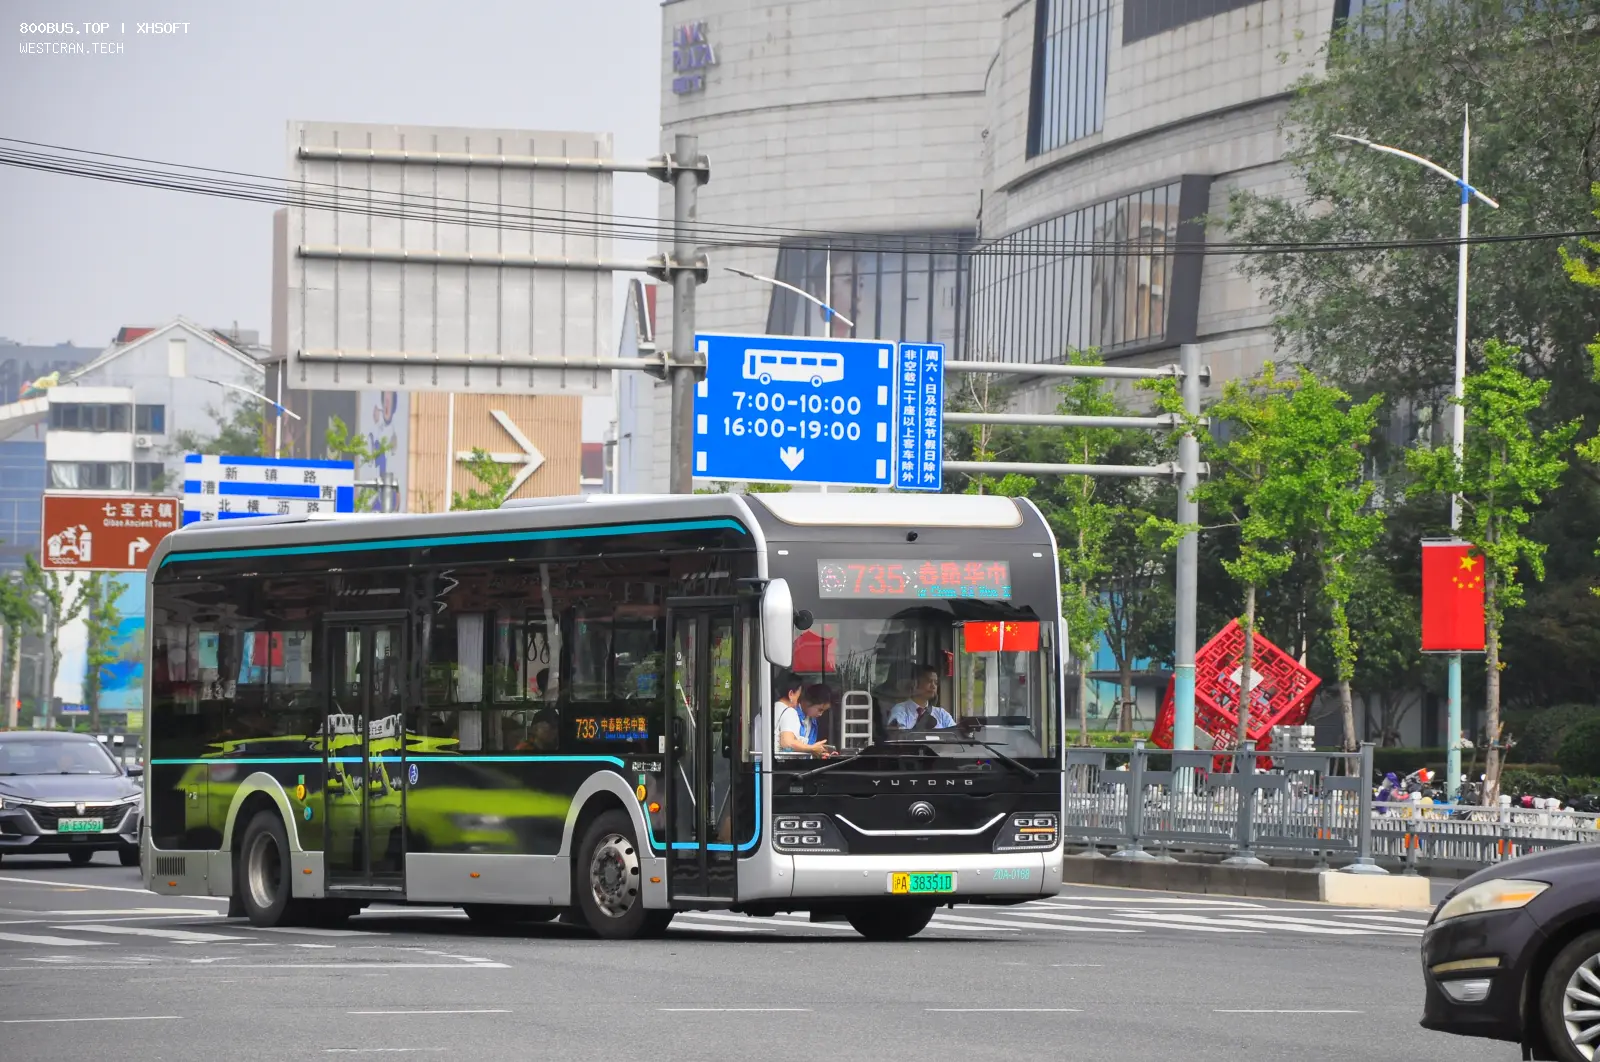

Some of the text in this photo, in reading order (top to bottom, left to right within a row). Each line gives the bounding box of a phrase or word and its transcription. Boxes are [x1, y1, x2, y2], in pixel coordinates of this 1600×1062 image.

[732, 391, 861, 415] 7:00-10:00
[902, 349, 917, 482] 非空载二十座以上客车除外
[923, 350, 939, 483] 周六、日及法定节假日除外
[723, 416, 861, 441] 16:00-19:00
[225, 466, 317, 483] 新镇路
[101, 502, 173, 518] 七宝古镇
[124, 519, 153, 528] Ancient
[154, 519, 173, 528] Town
[848, 564, 904, 594] 735
[575, 718, 596, 739] 735
[913, 876, 952, 890] 38351D
